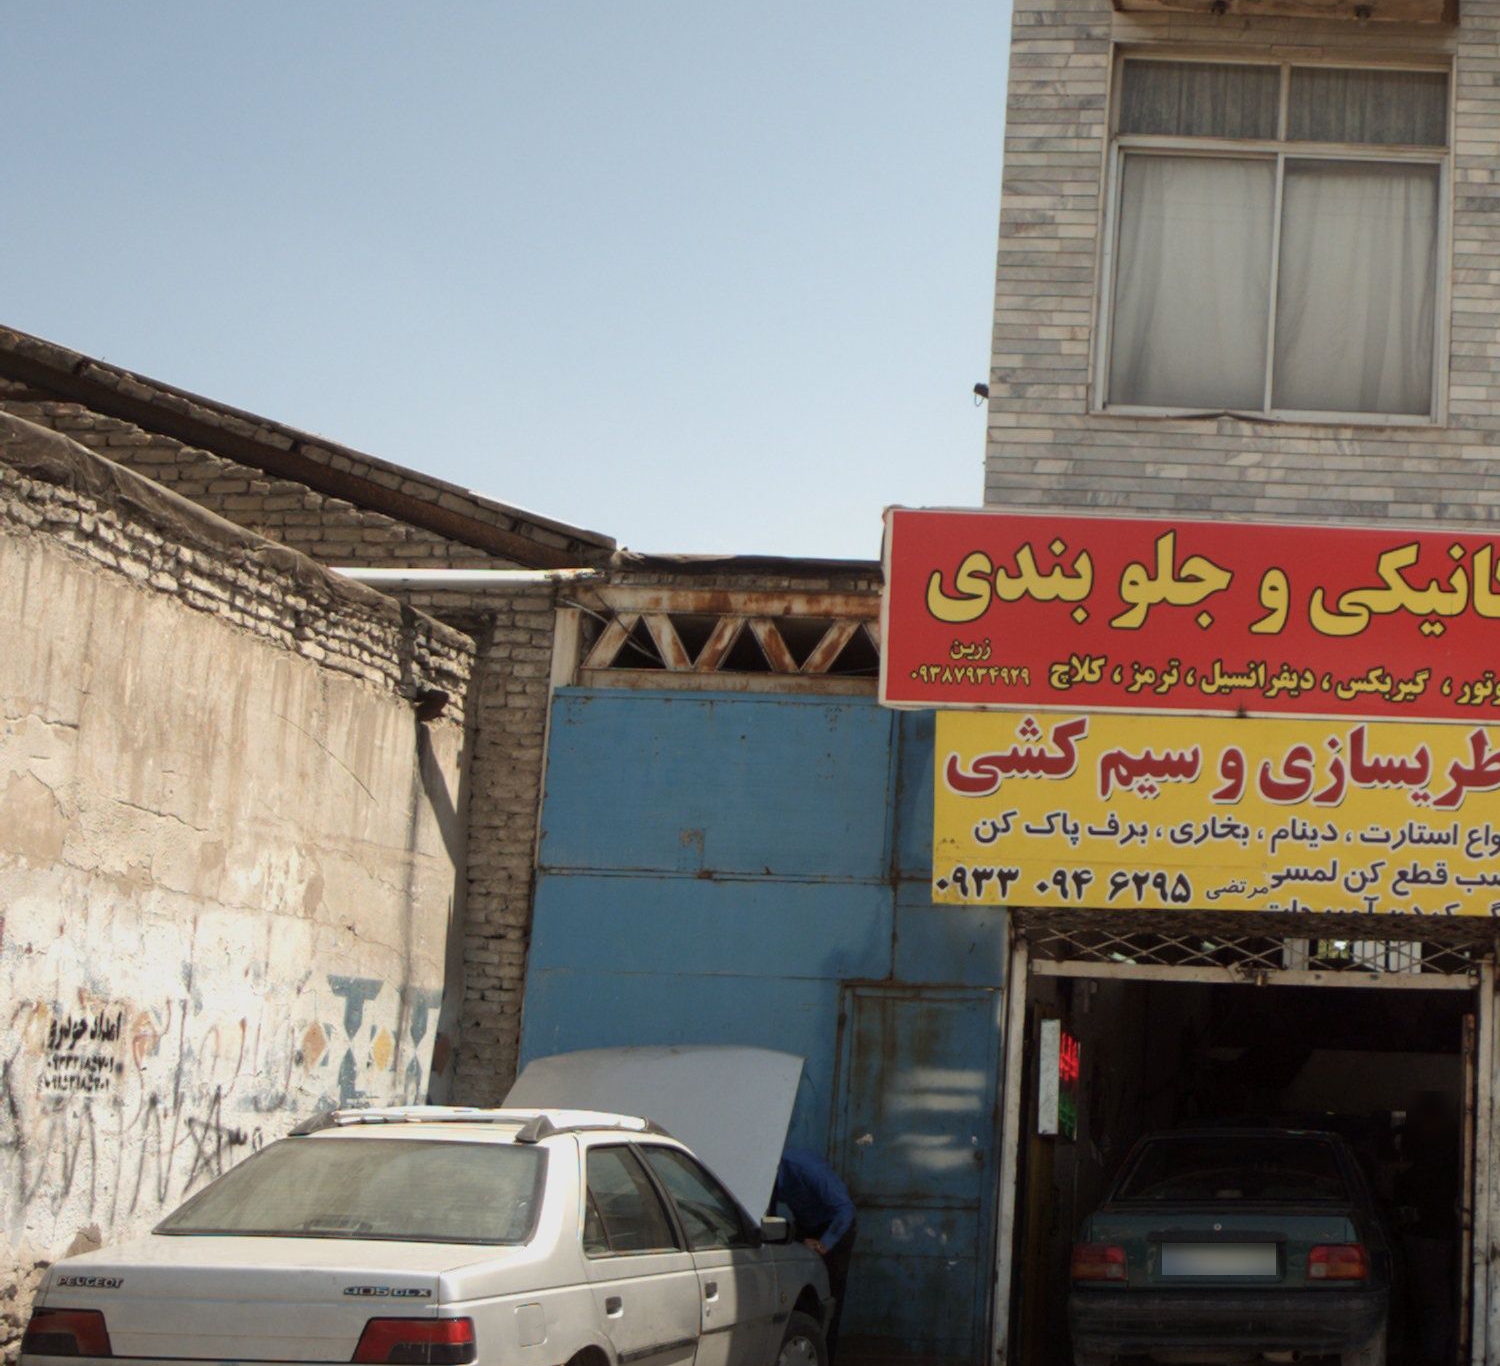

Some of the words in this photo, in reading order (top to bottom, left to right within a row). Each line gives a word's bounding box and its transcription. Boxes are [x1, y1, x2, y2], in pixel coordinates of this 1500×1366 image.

[926, 537, 1095, 624] بندی
[1111, 531, 1233, 629] جلو
[1250, 566, 1290, 633] و
[950, 638, 991, 659] زرین
[1049, 652, 1107, 690] کلاچ
[946, 717, 1089, 795] کشی
[1099, 742, 1201, 799] سیم
[1211, 747, 1246, 803] و
[974, 812, 1017, 844] کن
[1024, 812, 1078, 846] پاک
[1087, 816, 1148, 846] برف
[936, 866, 1020, 899] ۰۹۳۳
[1036, 869, 1094, 900] ۰۹۴
[1107, 871, 1192, 903] ۶۲۹۵
[1205, 880, 1269, 901] مرتضی
[1271, 860, 1337, 888] لمسی
[1344, 862, 1386, 893] کن
[1391, 862, 1448, 896] قطع
[57, 1275, 124, 1288] PEUGEOT
[344, 1286, 389, 1297] 405
[390, 1287, 432, 1297] GLX
